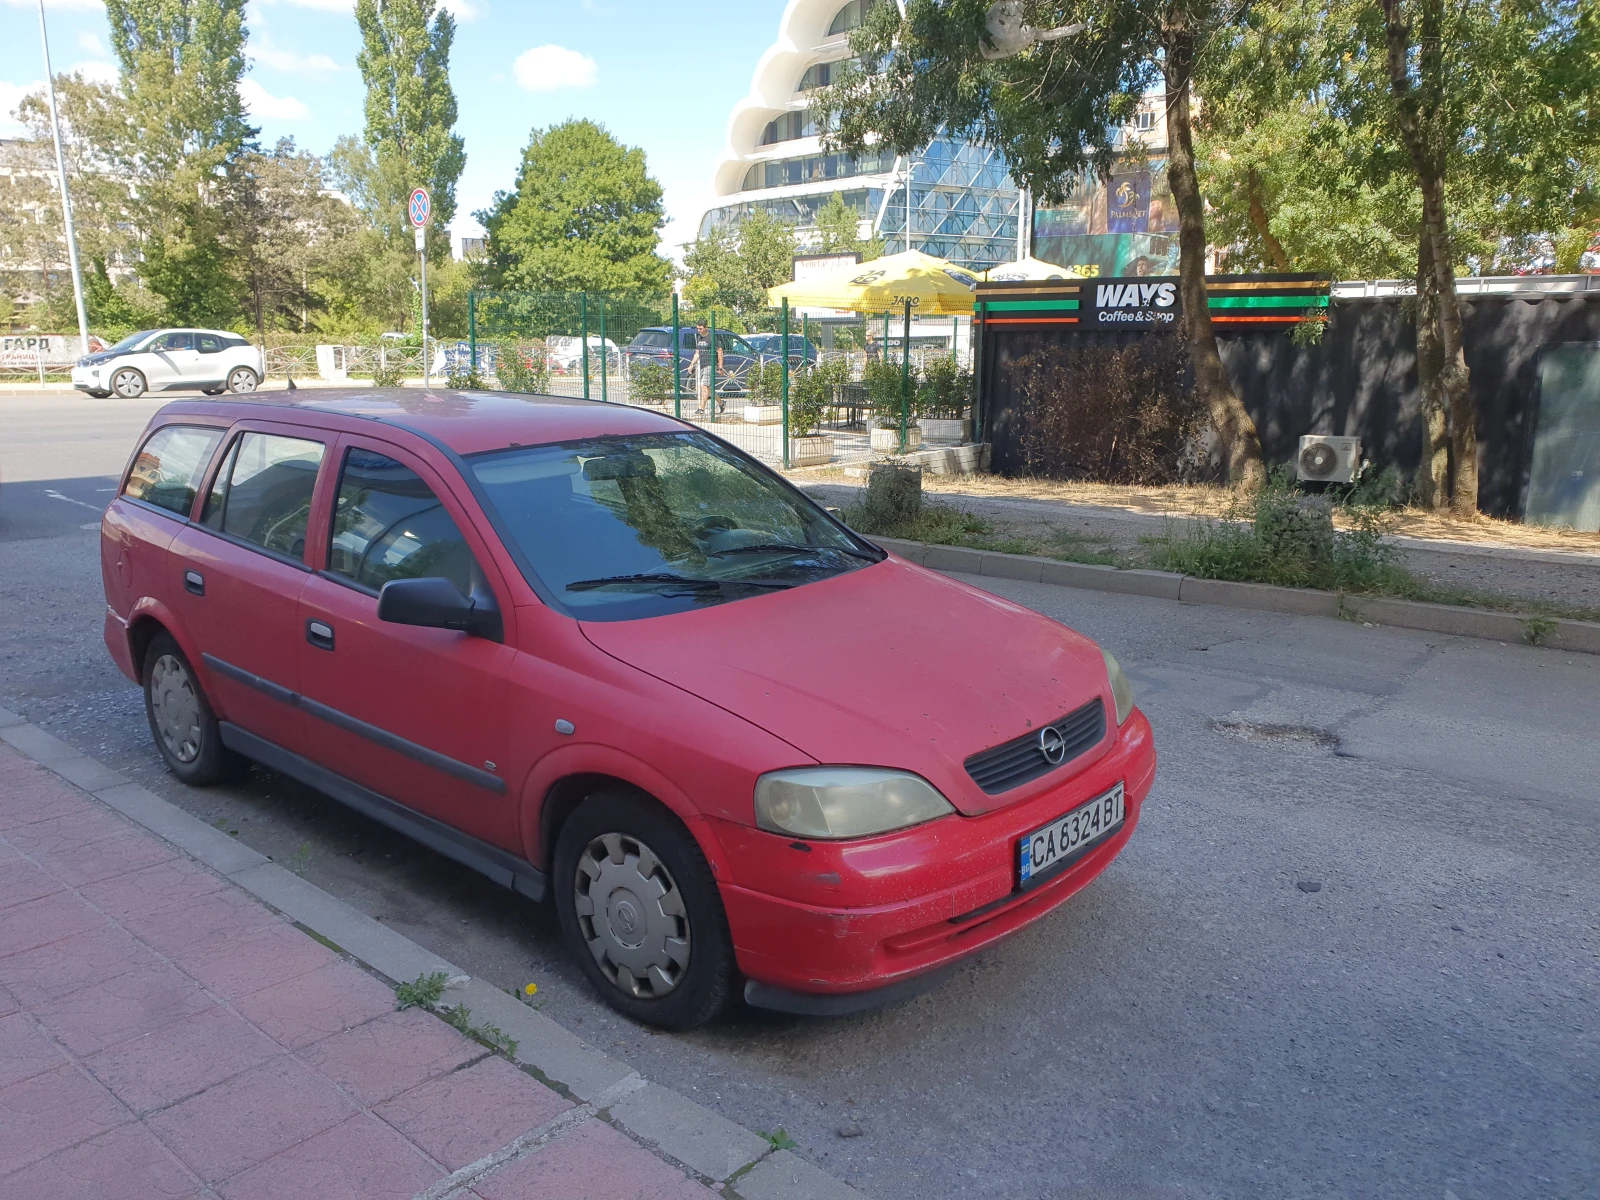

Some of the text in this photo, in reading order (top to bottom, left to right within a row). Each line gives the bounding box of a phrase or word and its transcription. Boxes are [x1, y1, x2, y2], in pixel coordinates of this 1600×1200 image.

[1073, 264, 1099, 277] 365
[1096, 282, 1177, 307] WAYS
[1098, 311, 1134, 322] Coffee
[1135, 311, 1144, 321] &
[4, 338, 51, 352] ГАРД
[1032, 789, 1122, 867] CA 8324 BT
[1021, 863, 1030, 875] BG
